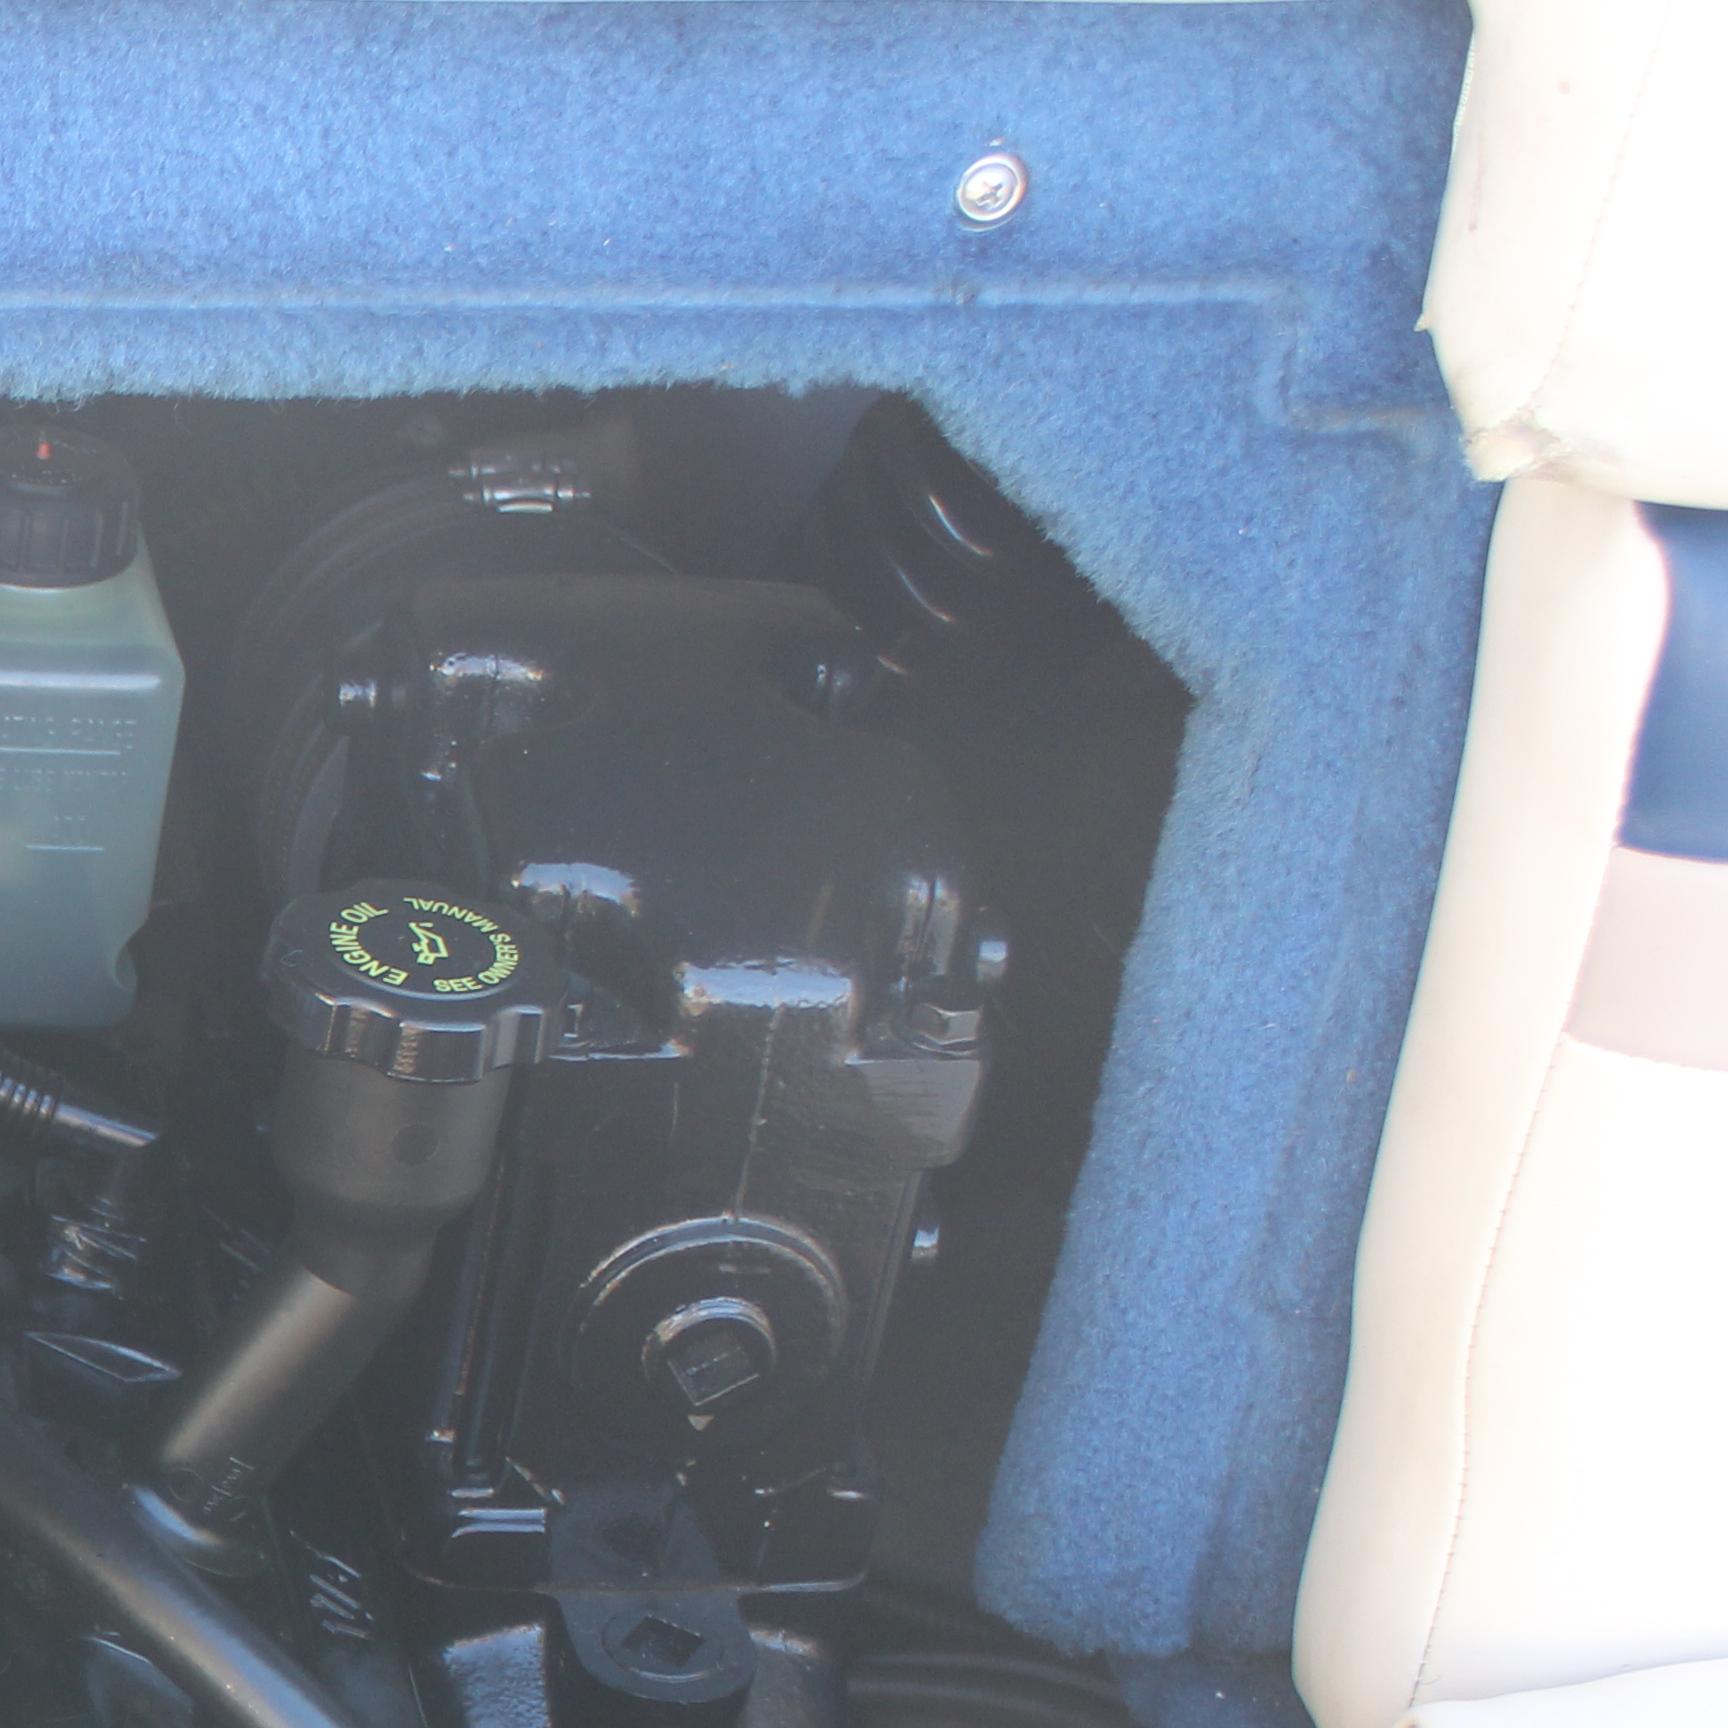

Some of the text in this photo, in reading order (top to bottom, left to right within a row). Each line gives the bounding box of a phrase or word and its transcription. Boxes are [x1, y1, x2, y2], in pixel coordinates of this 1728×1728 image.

[329, 902, 409, 986] ENGINE OIL
[403, 897, 520, 992] SEE OWNERS MANUAL
